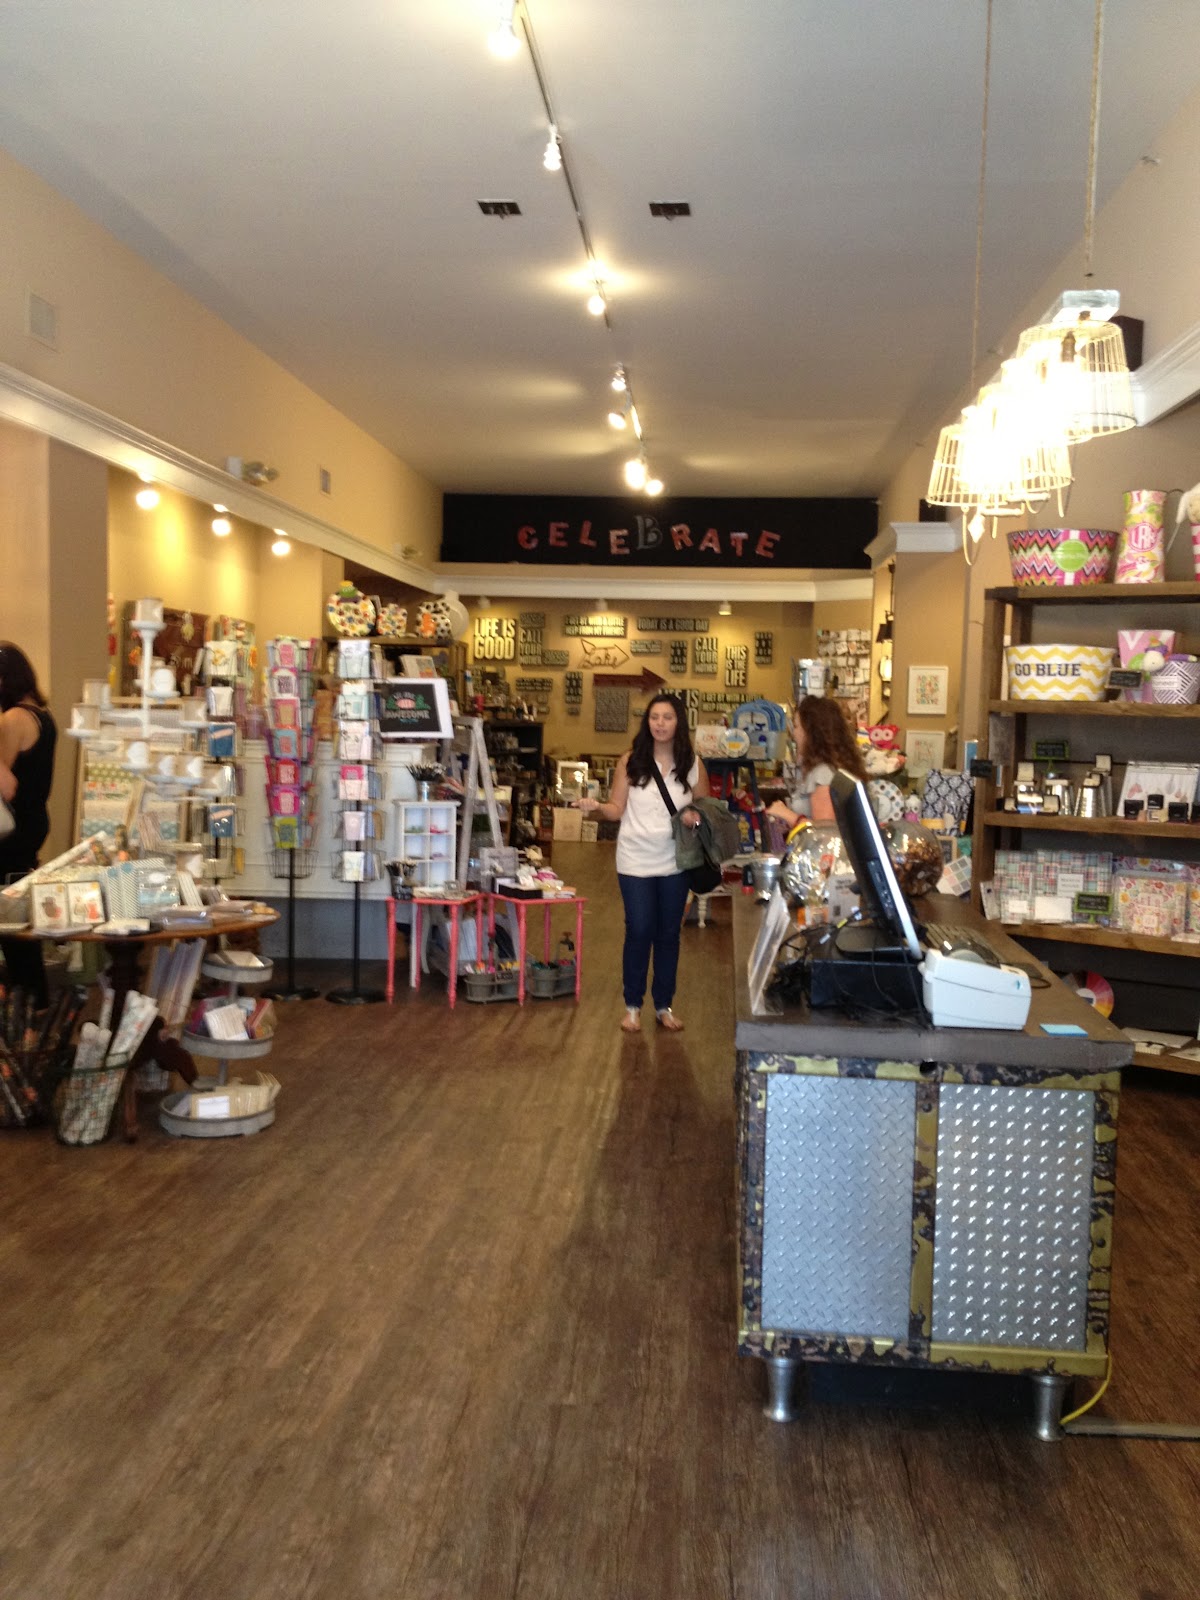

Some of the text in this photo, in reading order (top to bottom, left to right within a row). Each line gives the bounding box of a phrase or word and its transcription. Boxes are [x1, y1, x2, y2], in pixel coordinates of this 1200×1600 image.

[517, 515, 782, 558] CELEBRATE
[475, 617, 499, 637] LIFE
[502, 618, 516, 638] IS
[638, 618, 709, 631] TODAY IS A GOOD DAY
[520, 628, 542, 643] CALL
[475, 636, 515, 660] GOOD
[520, 643, 542, 655] YOUR
[695, 637, 717, 651] CALL
[695, 651, 717, 663] YOUR
[726, 645, 747, 660] THIS
[695, 663, 717, 673] MOTHER
[727, 660, 746, 670] IS THE
[1014, 663, 1081, 677] GO BLUE
[726, 670, 746, 686] LIFE
[686, 689, 699, 708] IS
[706, 693, 716, 702] GET
[717, 693, 724, 702] BY
[726, 693, 740, 702] WITH
